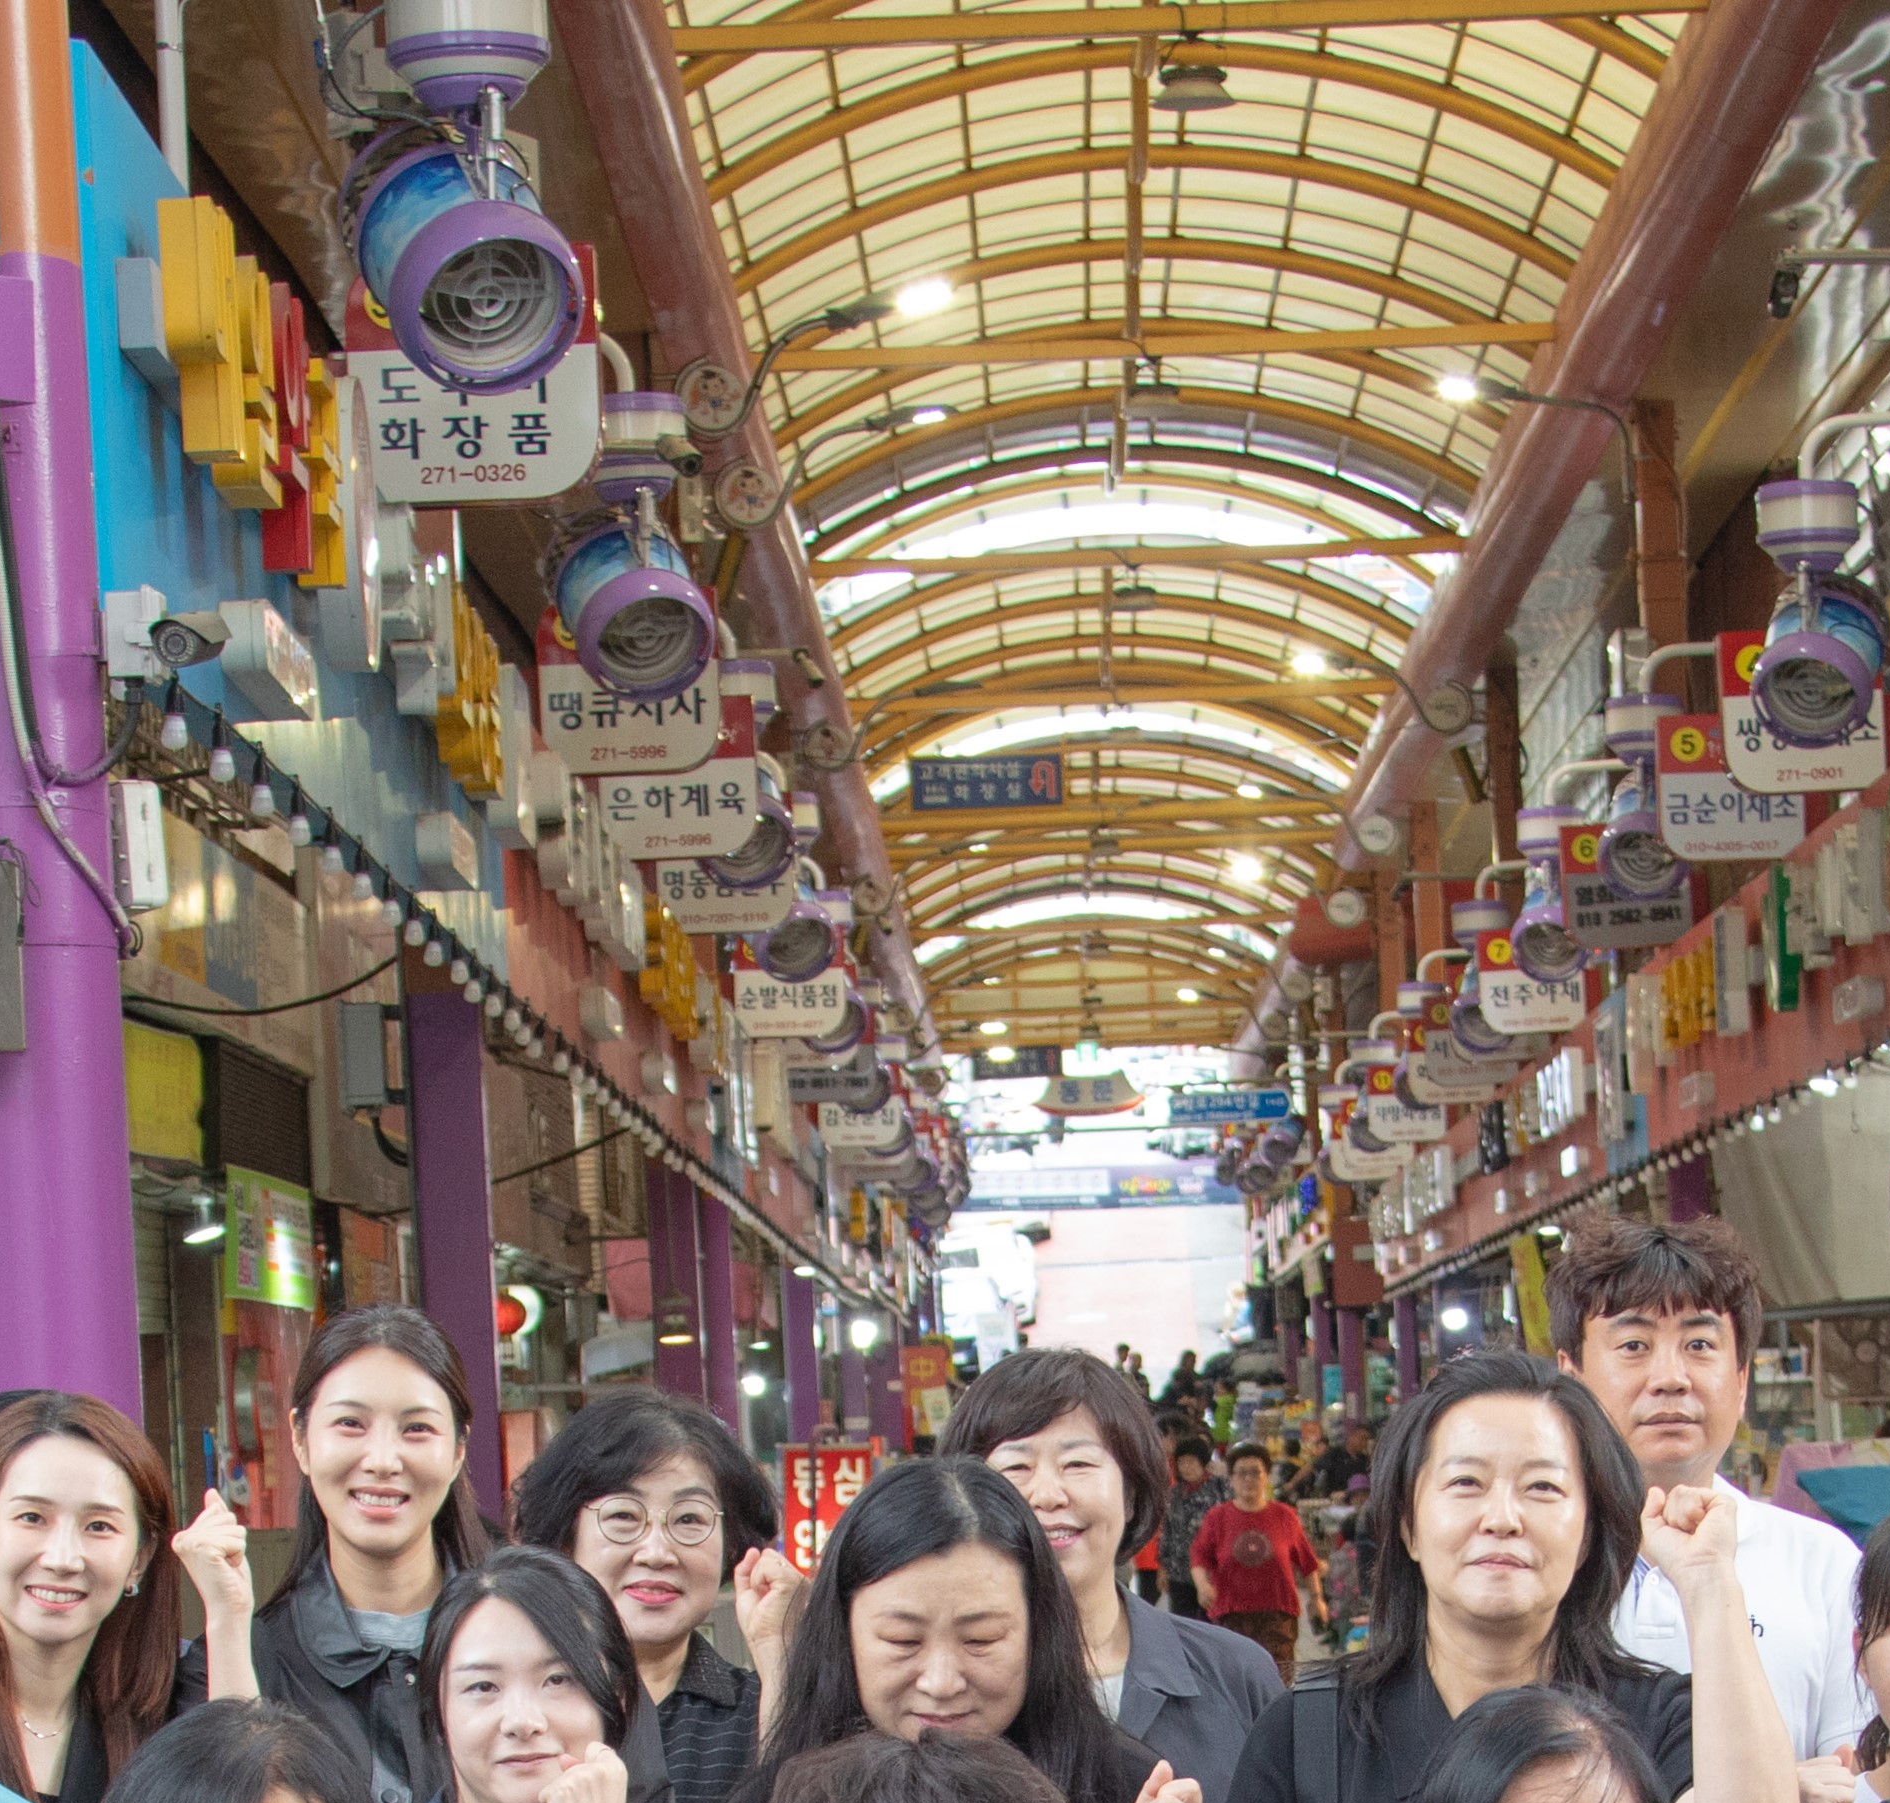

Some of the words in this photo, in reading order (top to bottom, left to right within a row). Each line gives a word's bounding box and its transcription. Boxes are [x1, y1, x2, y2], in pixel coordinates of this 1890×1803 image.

[379, 412, 551, 460] 화장품
[421, 463, 526, 485] 271-0326
[591, 746, 667, 761] 271-5996
[1680, 734, 1695, 755] 5
[1777, 768, 1843, 781] 271-0901
[608, 782, 747, 821] 은하계육
[644, 833, 711, 848] 271-5996
[1580, 838, 1593, 858] 6
[1497, 943, 1505, 960] 7
